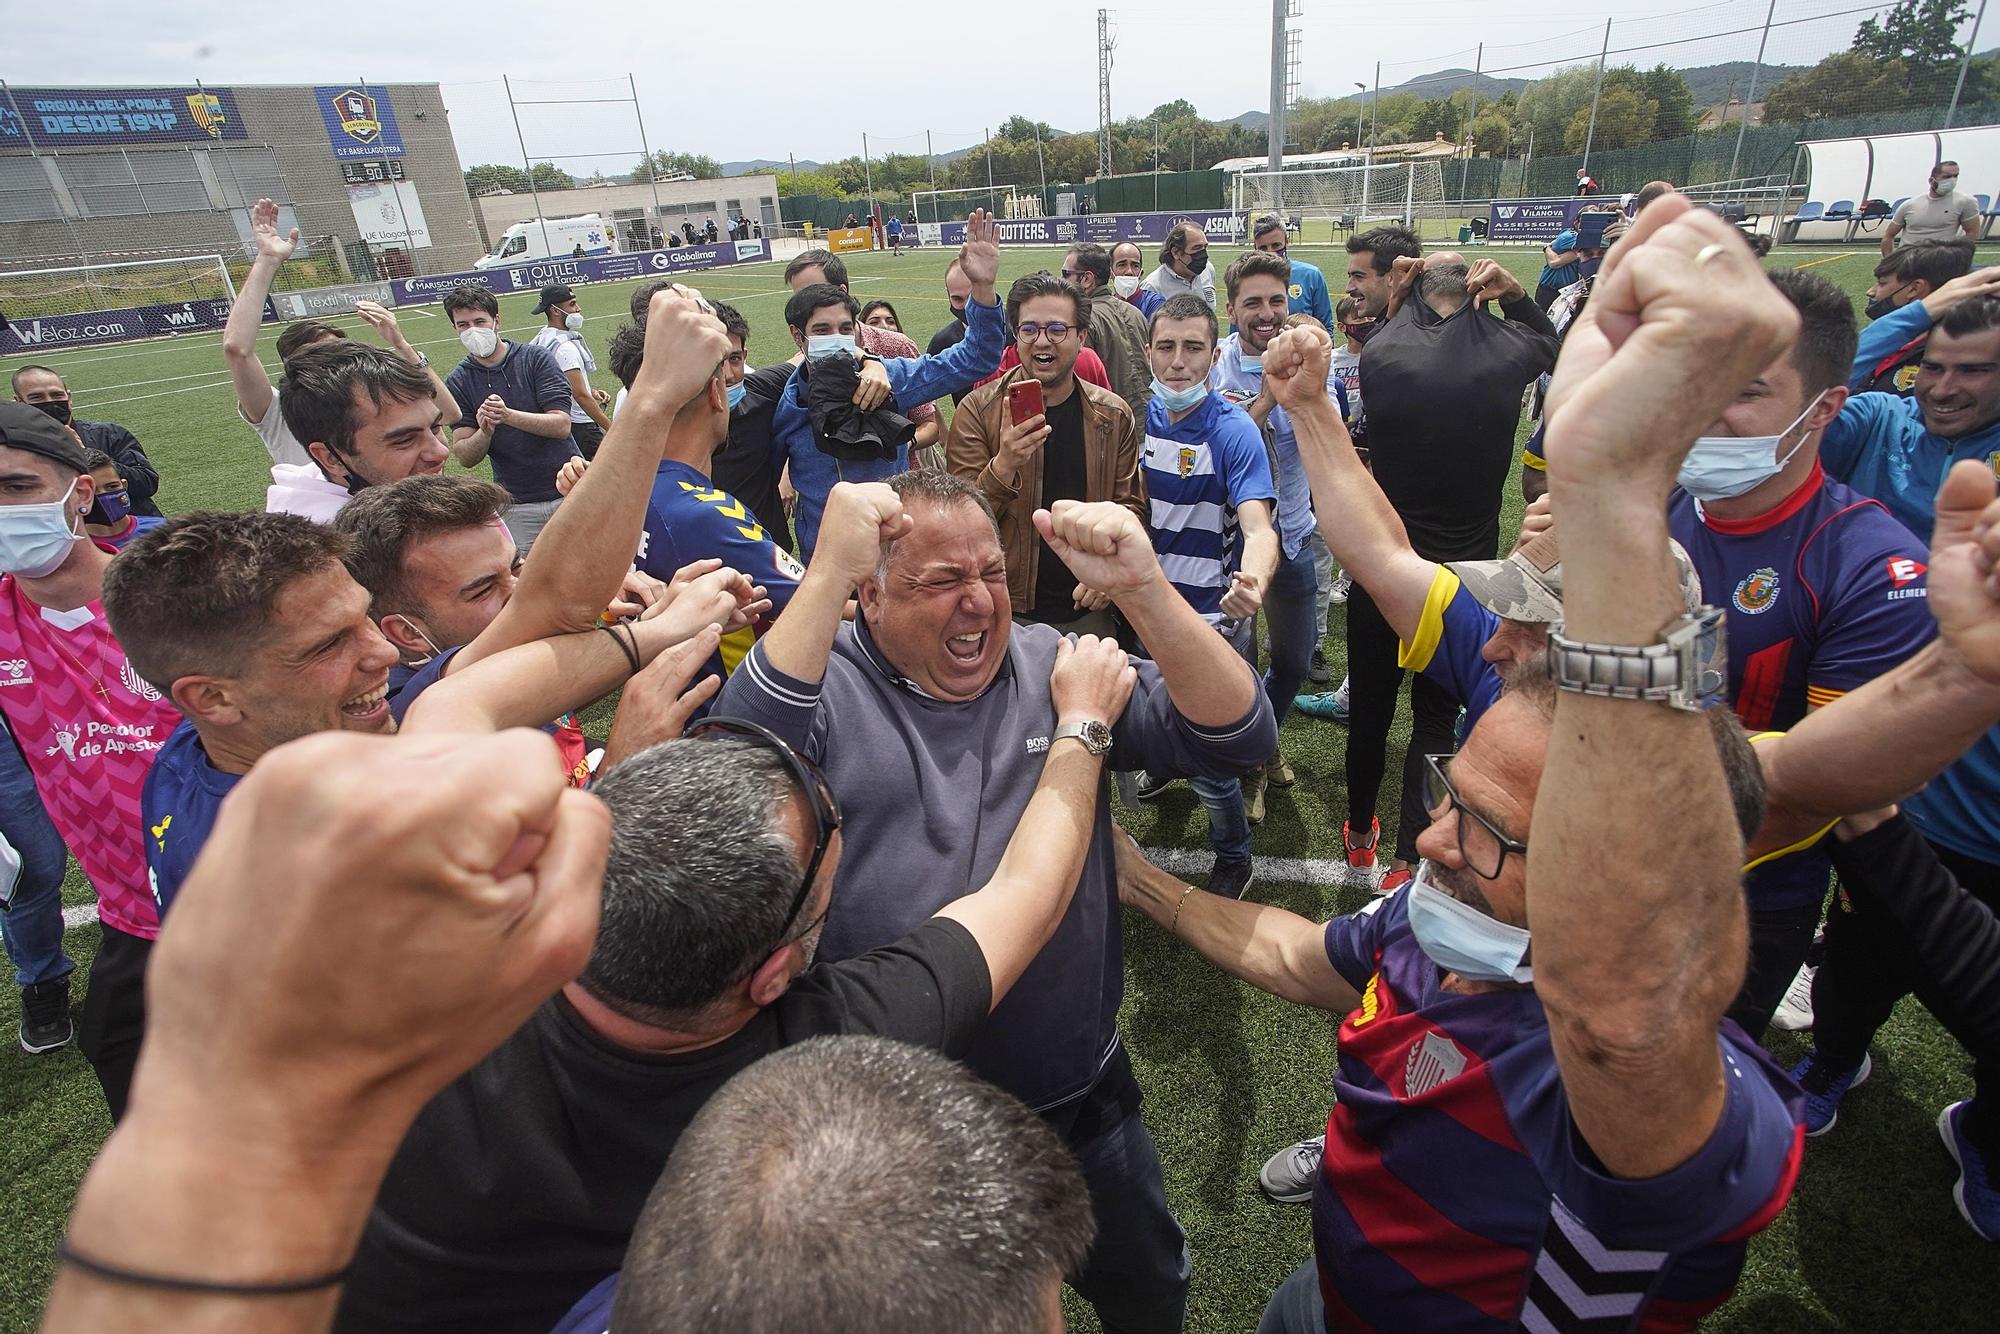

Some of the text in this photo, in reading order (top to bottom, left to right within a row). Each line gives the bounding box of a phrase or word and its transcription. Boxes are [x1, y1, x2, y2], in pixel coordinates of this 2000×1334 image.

[41, 115, 124, 133] DESDE
[123, 113, 178, 132] 1947
[366, 167, 383, 181] 90
[1521, 209, 1564, 217] VILANOVA
[1000, 223, 1050, 240] OOTTERS.
[670, 250, 717, 263] Globalimar
[531, 262, 579, 279] OUTLET
[416, 281, 453, 291] MARISCH
[453, 276, 488, 286] COTCHO
[1887, 588, 1927, 600] ELEMEN
[79, 741, 102, 757] de
[1025, 736, 1049, 749] BOSS
